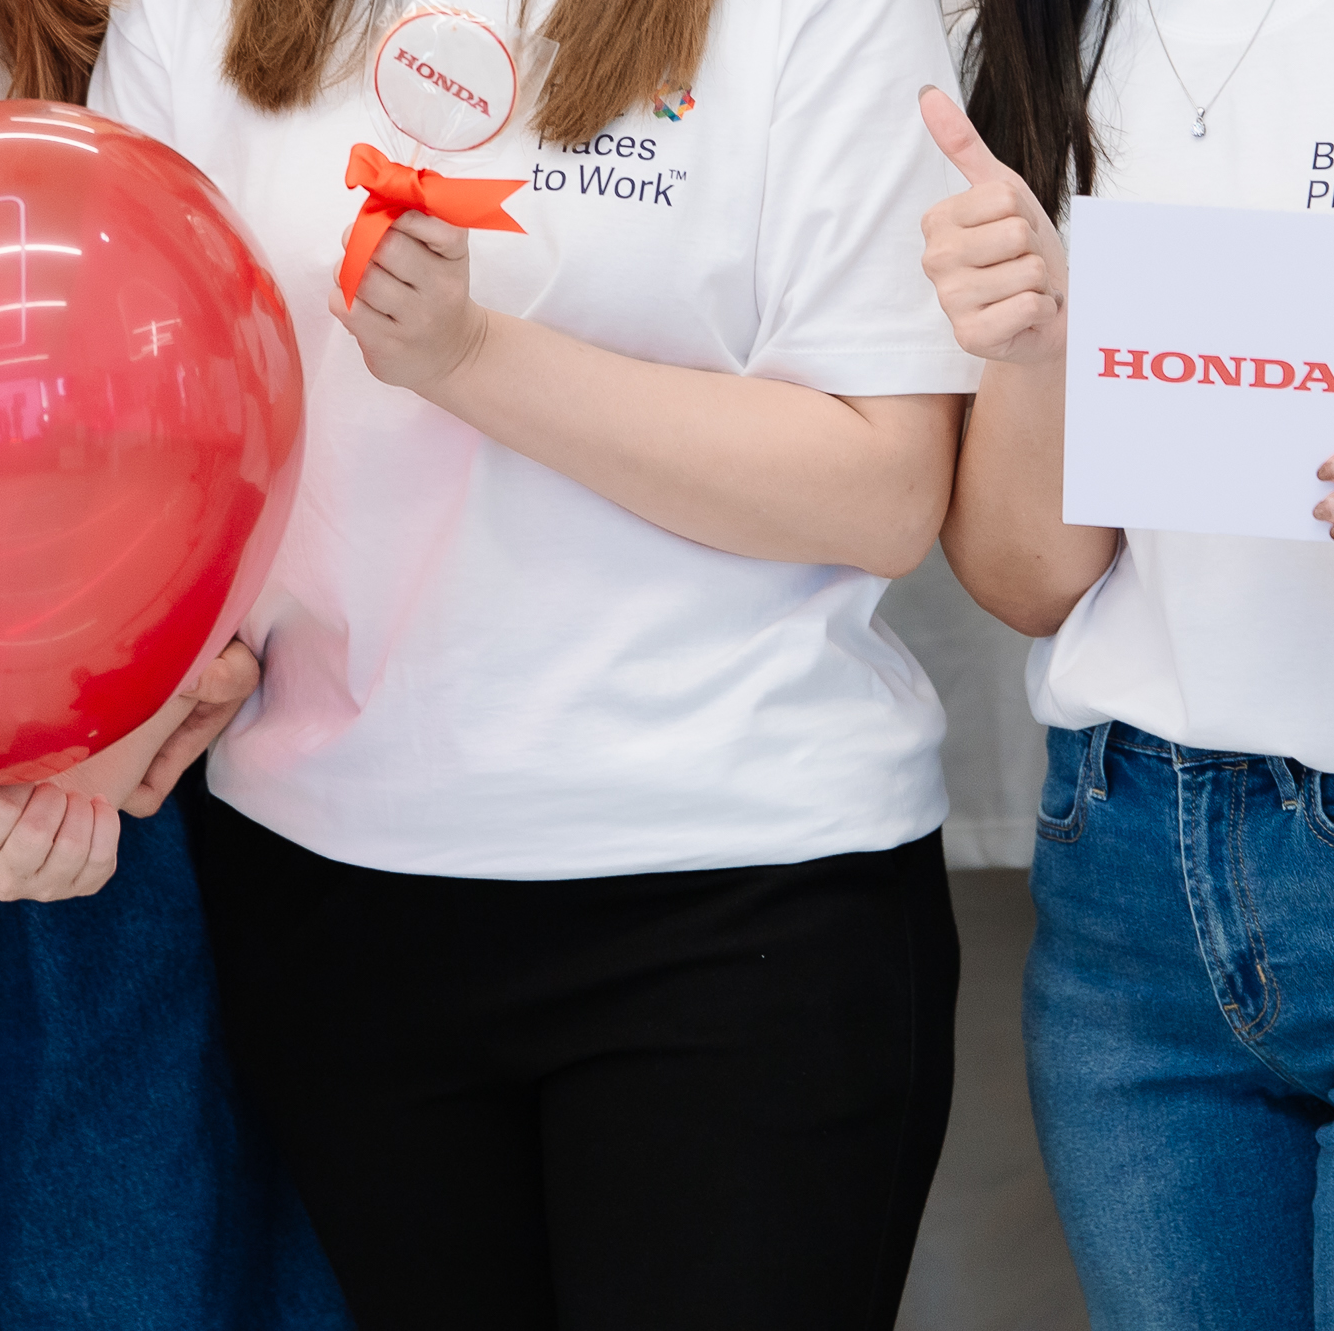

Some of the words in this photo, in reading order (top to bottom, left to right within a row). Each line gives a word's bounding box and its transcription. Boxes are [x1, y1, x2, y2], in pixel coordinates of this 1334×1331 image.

[394, 46, 492, 118] HONDA
[538, 127, 657, 161] aces
[532, 163, 566, 191] to
